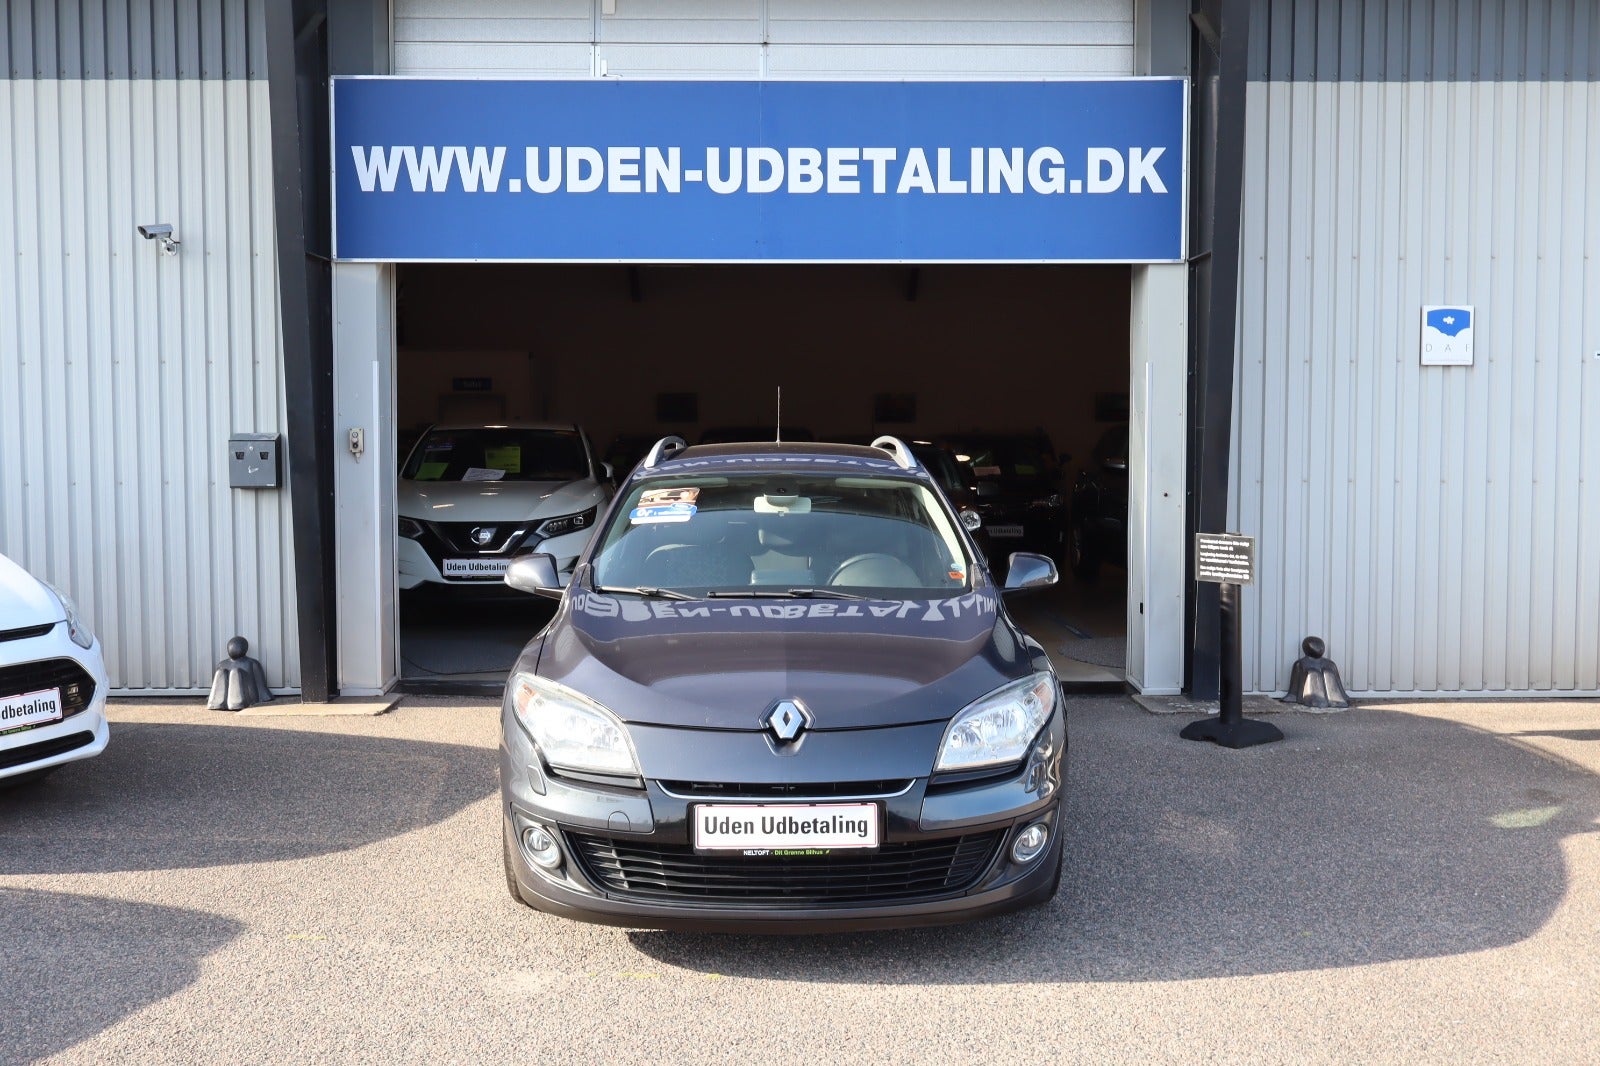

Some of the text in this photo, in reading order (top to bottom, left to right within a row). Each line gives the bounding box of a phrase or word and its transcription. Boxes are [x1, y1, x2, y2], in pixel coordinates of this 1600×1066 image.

[351, 145, 1168, 194] WWW.UDEN-UDBETALING.DK
[446, 562, 467, 571] Uden
[0, 699, 56, 720] dbetaling
[704, 815, 868, 838] Uden Udbetaling
